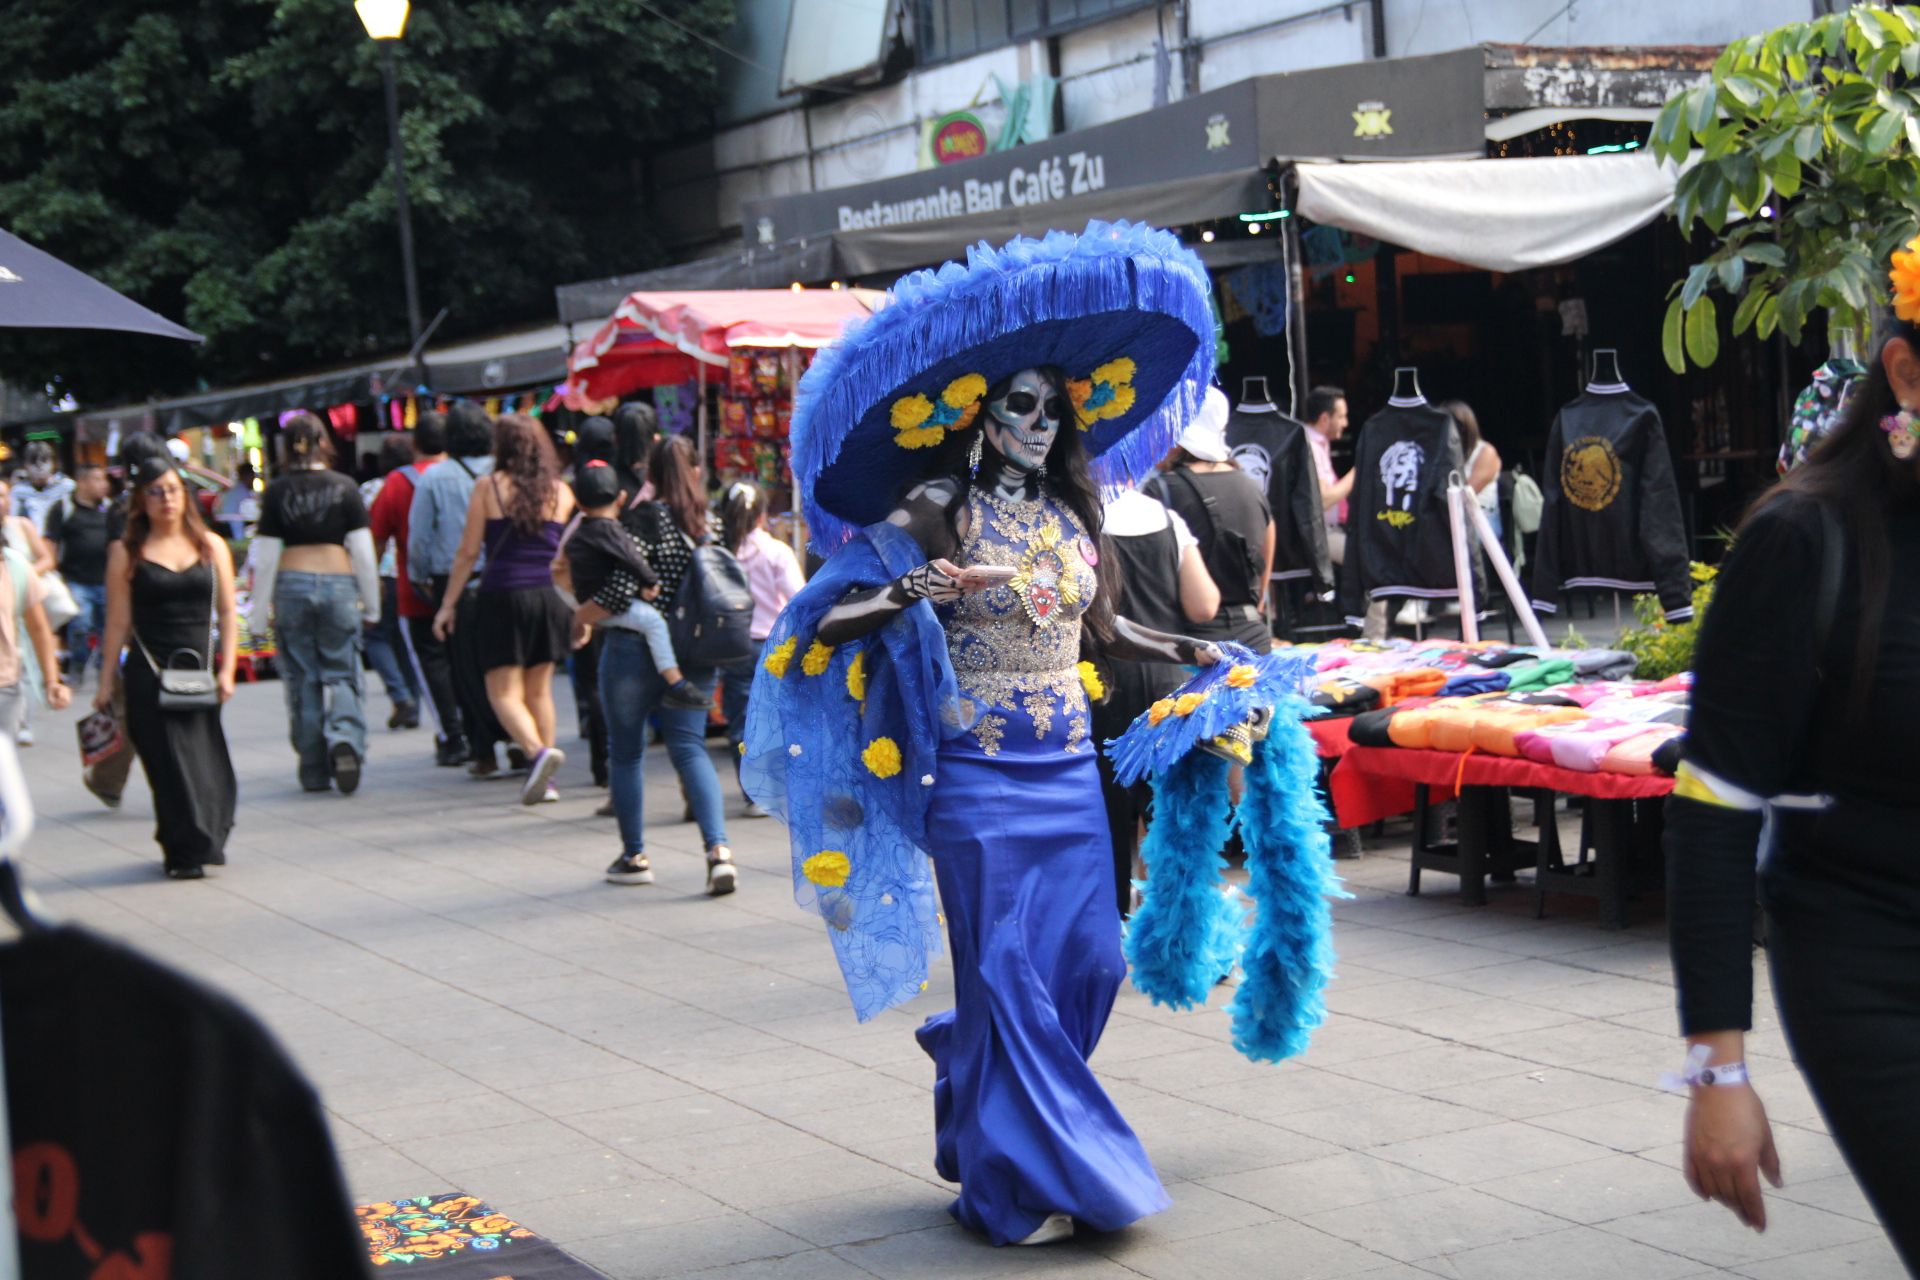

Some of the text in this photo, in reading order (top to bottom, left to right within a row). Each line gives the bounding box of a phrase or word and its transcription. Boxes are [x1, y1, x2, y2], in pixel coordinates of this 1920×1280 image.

[965, 179, 1005, 214] Bar
[1009, 157, 1065, 207] Café
[1069, 152, 1106, 195] Zu
